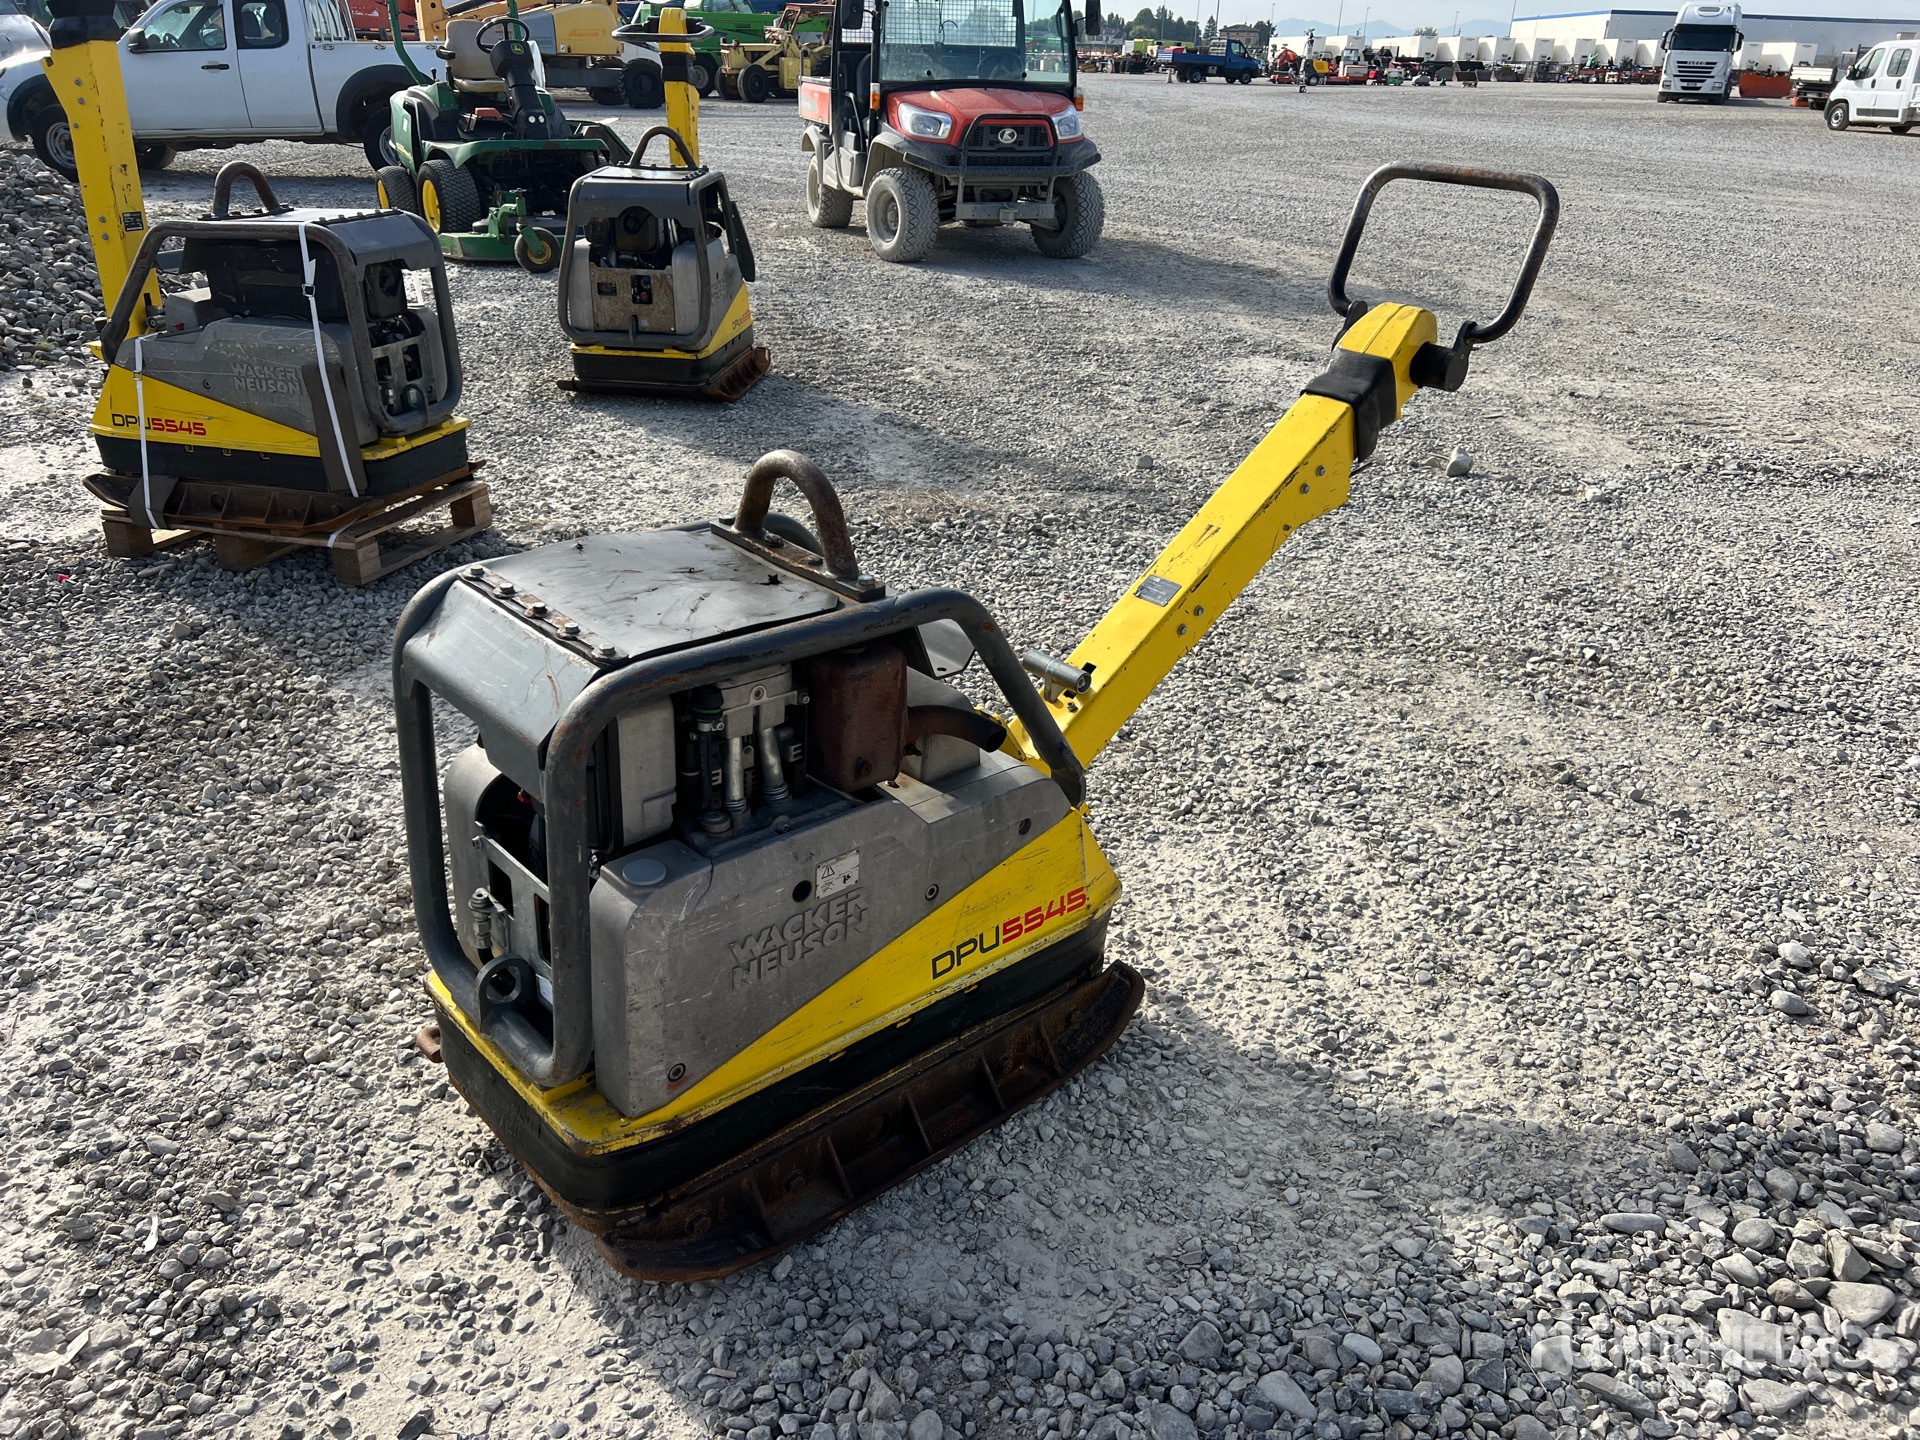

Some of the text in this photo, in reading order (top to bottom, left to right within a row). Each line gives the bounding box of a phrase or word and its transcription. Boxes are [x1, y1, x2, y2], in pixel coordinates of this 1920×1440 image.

[230, 362, 300, 382] WACKER
[233, 376, 303, 396] NEUSON
[728, 886, 868, 965] WACKER
[731, 908, 868, 992] NEUSON
[931, 886, 1087, 980] DPU5545
